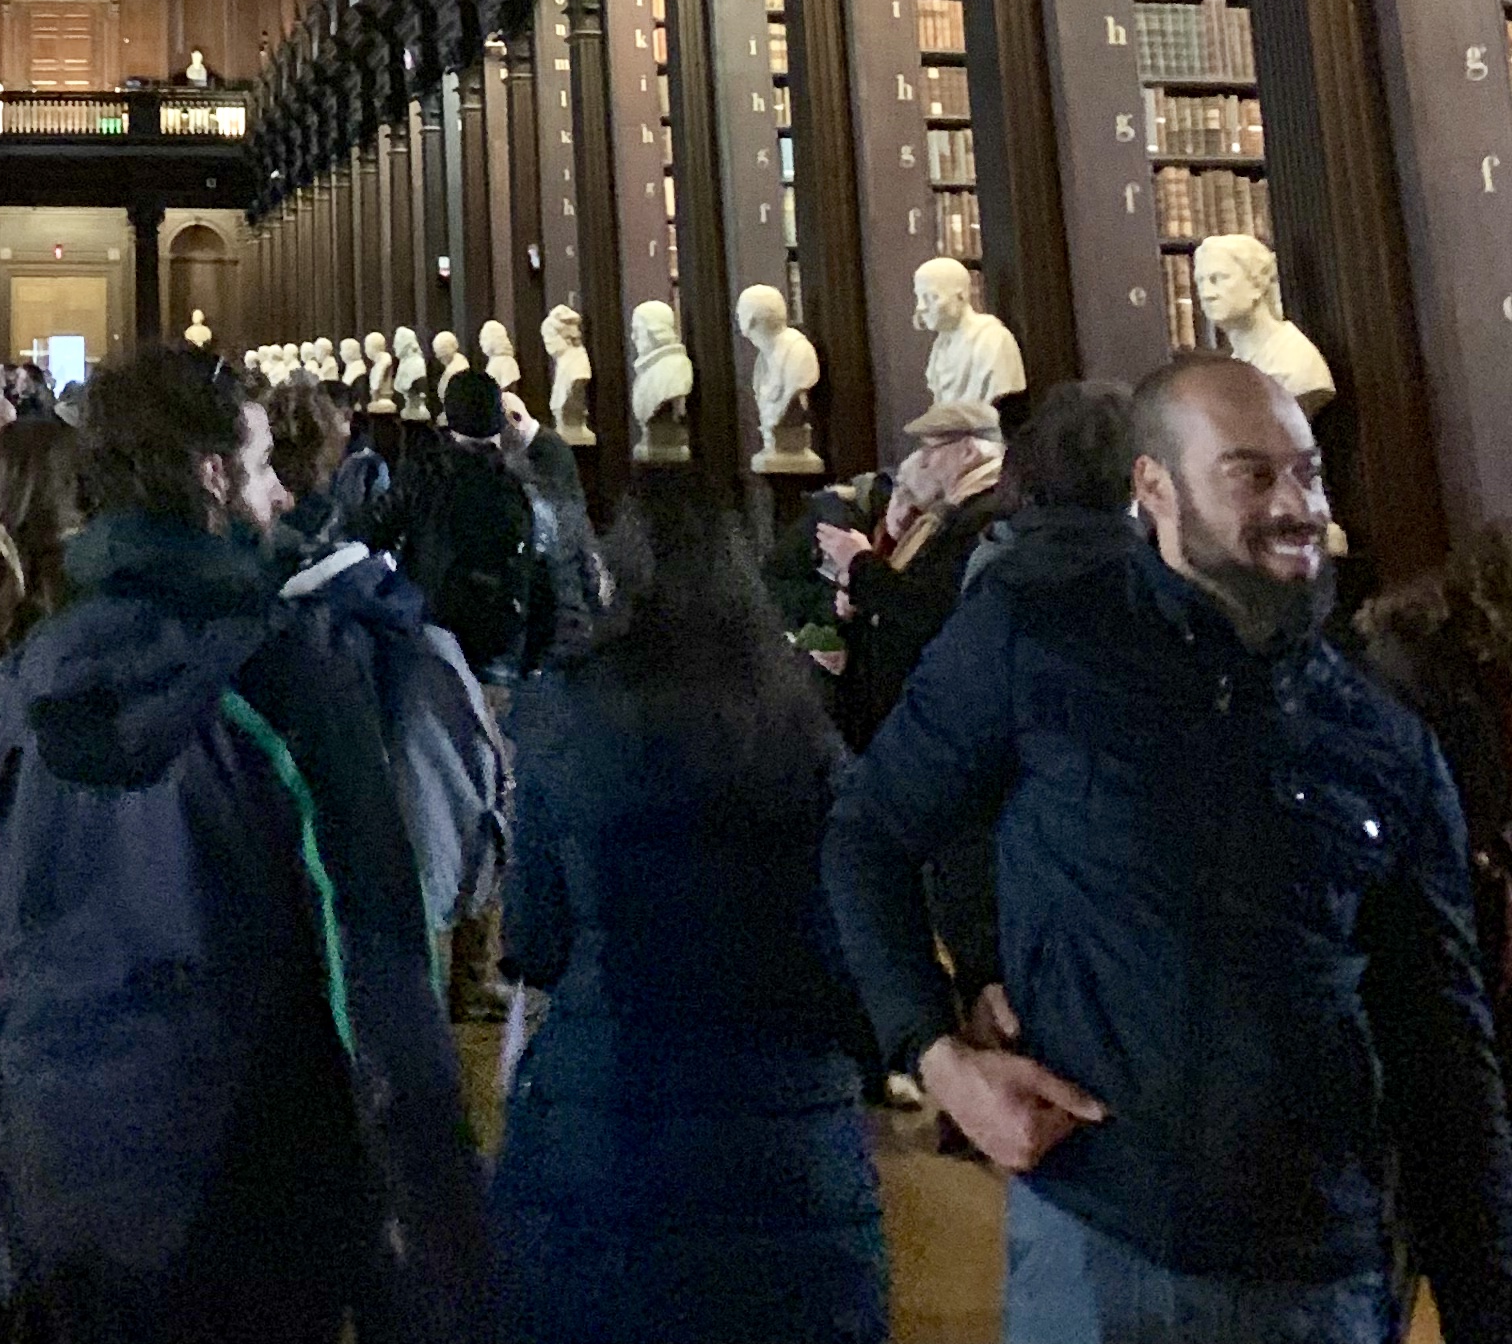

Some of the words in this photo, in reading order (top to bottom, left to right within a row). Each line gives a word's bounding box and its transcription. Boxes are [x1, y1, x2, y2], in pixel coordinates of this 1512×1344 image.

[636, 29, 647, 47] k
[1106, 16, 1127, 45] h
[555, 59, 570, 70] m
[897, 75, 912, 100] h
[752, 93, 765, 111] h
[642, 124, 653, 143] h
[564, 199, 574, 215] h
